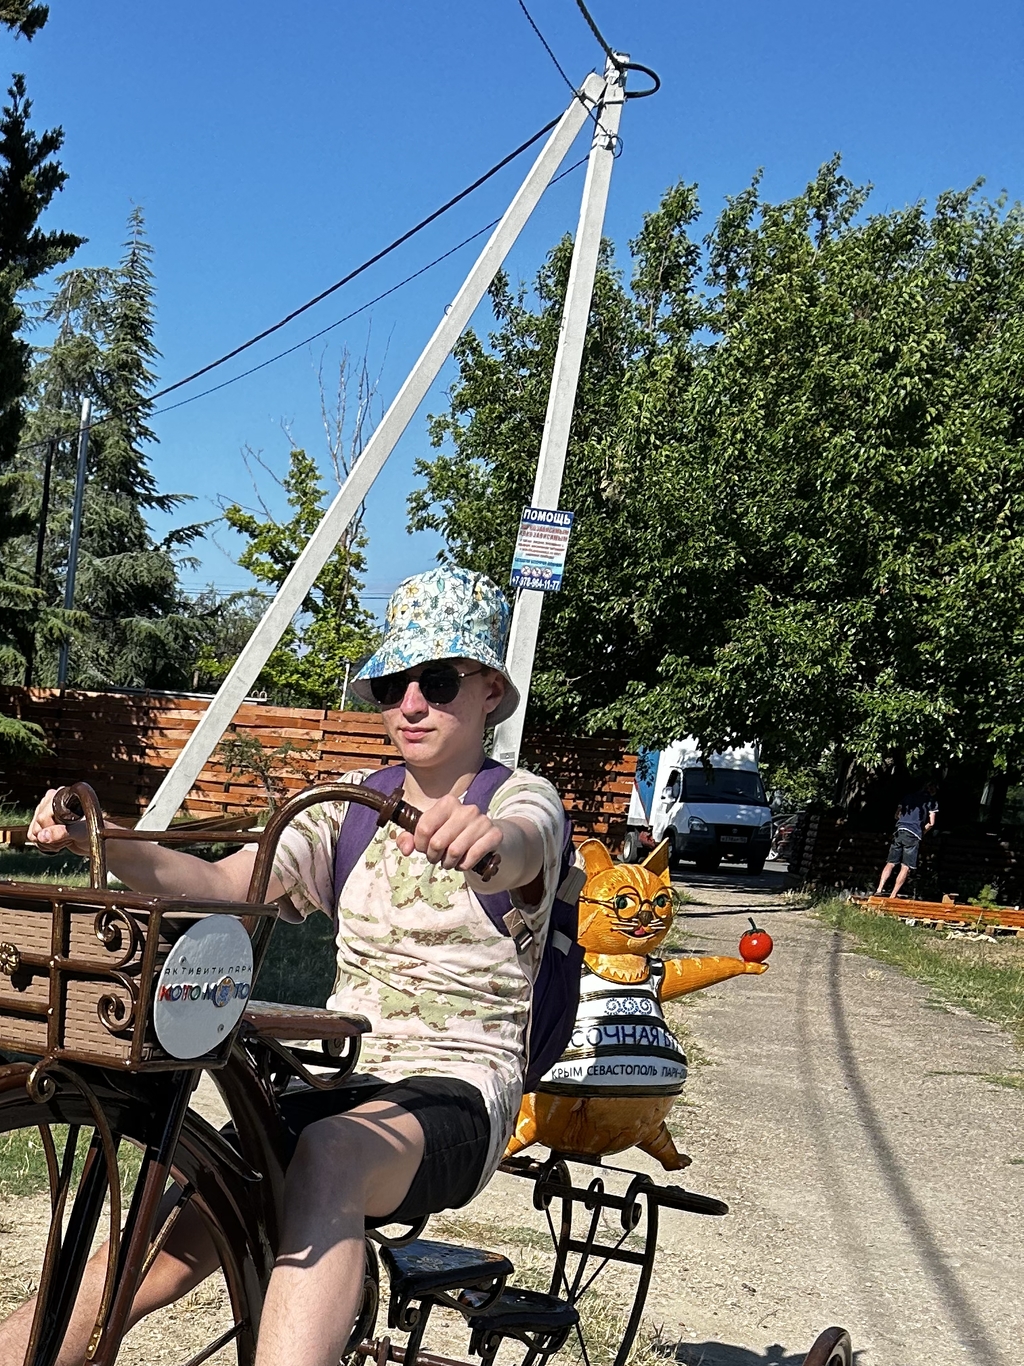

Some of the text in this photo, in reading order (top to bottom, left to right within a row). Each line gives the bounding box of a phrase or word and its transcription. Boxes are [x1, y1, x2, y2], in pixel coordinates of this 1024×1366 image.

[523, 508, 571, 526] ПОМОЩЬ
[164, 965, 252, 976] АКТИВИТИ ПАРК
[569, 1025, 660, 1049] СОЧНАЯ
[551, 1066, 583, 1080] КРЫМ
[587, 1063, 658, 1076] СЕВАСТОПОЛЬ
